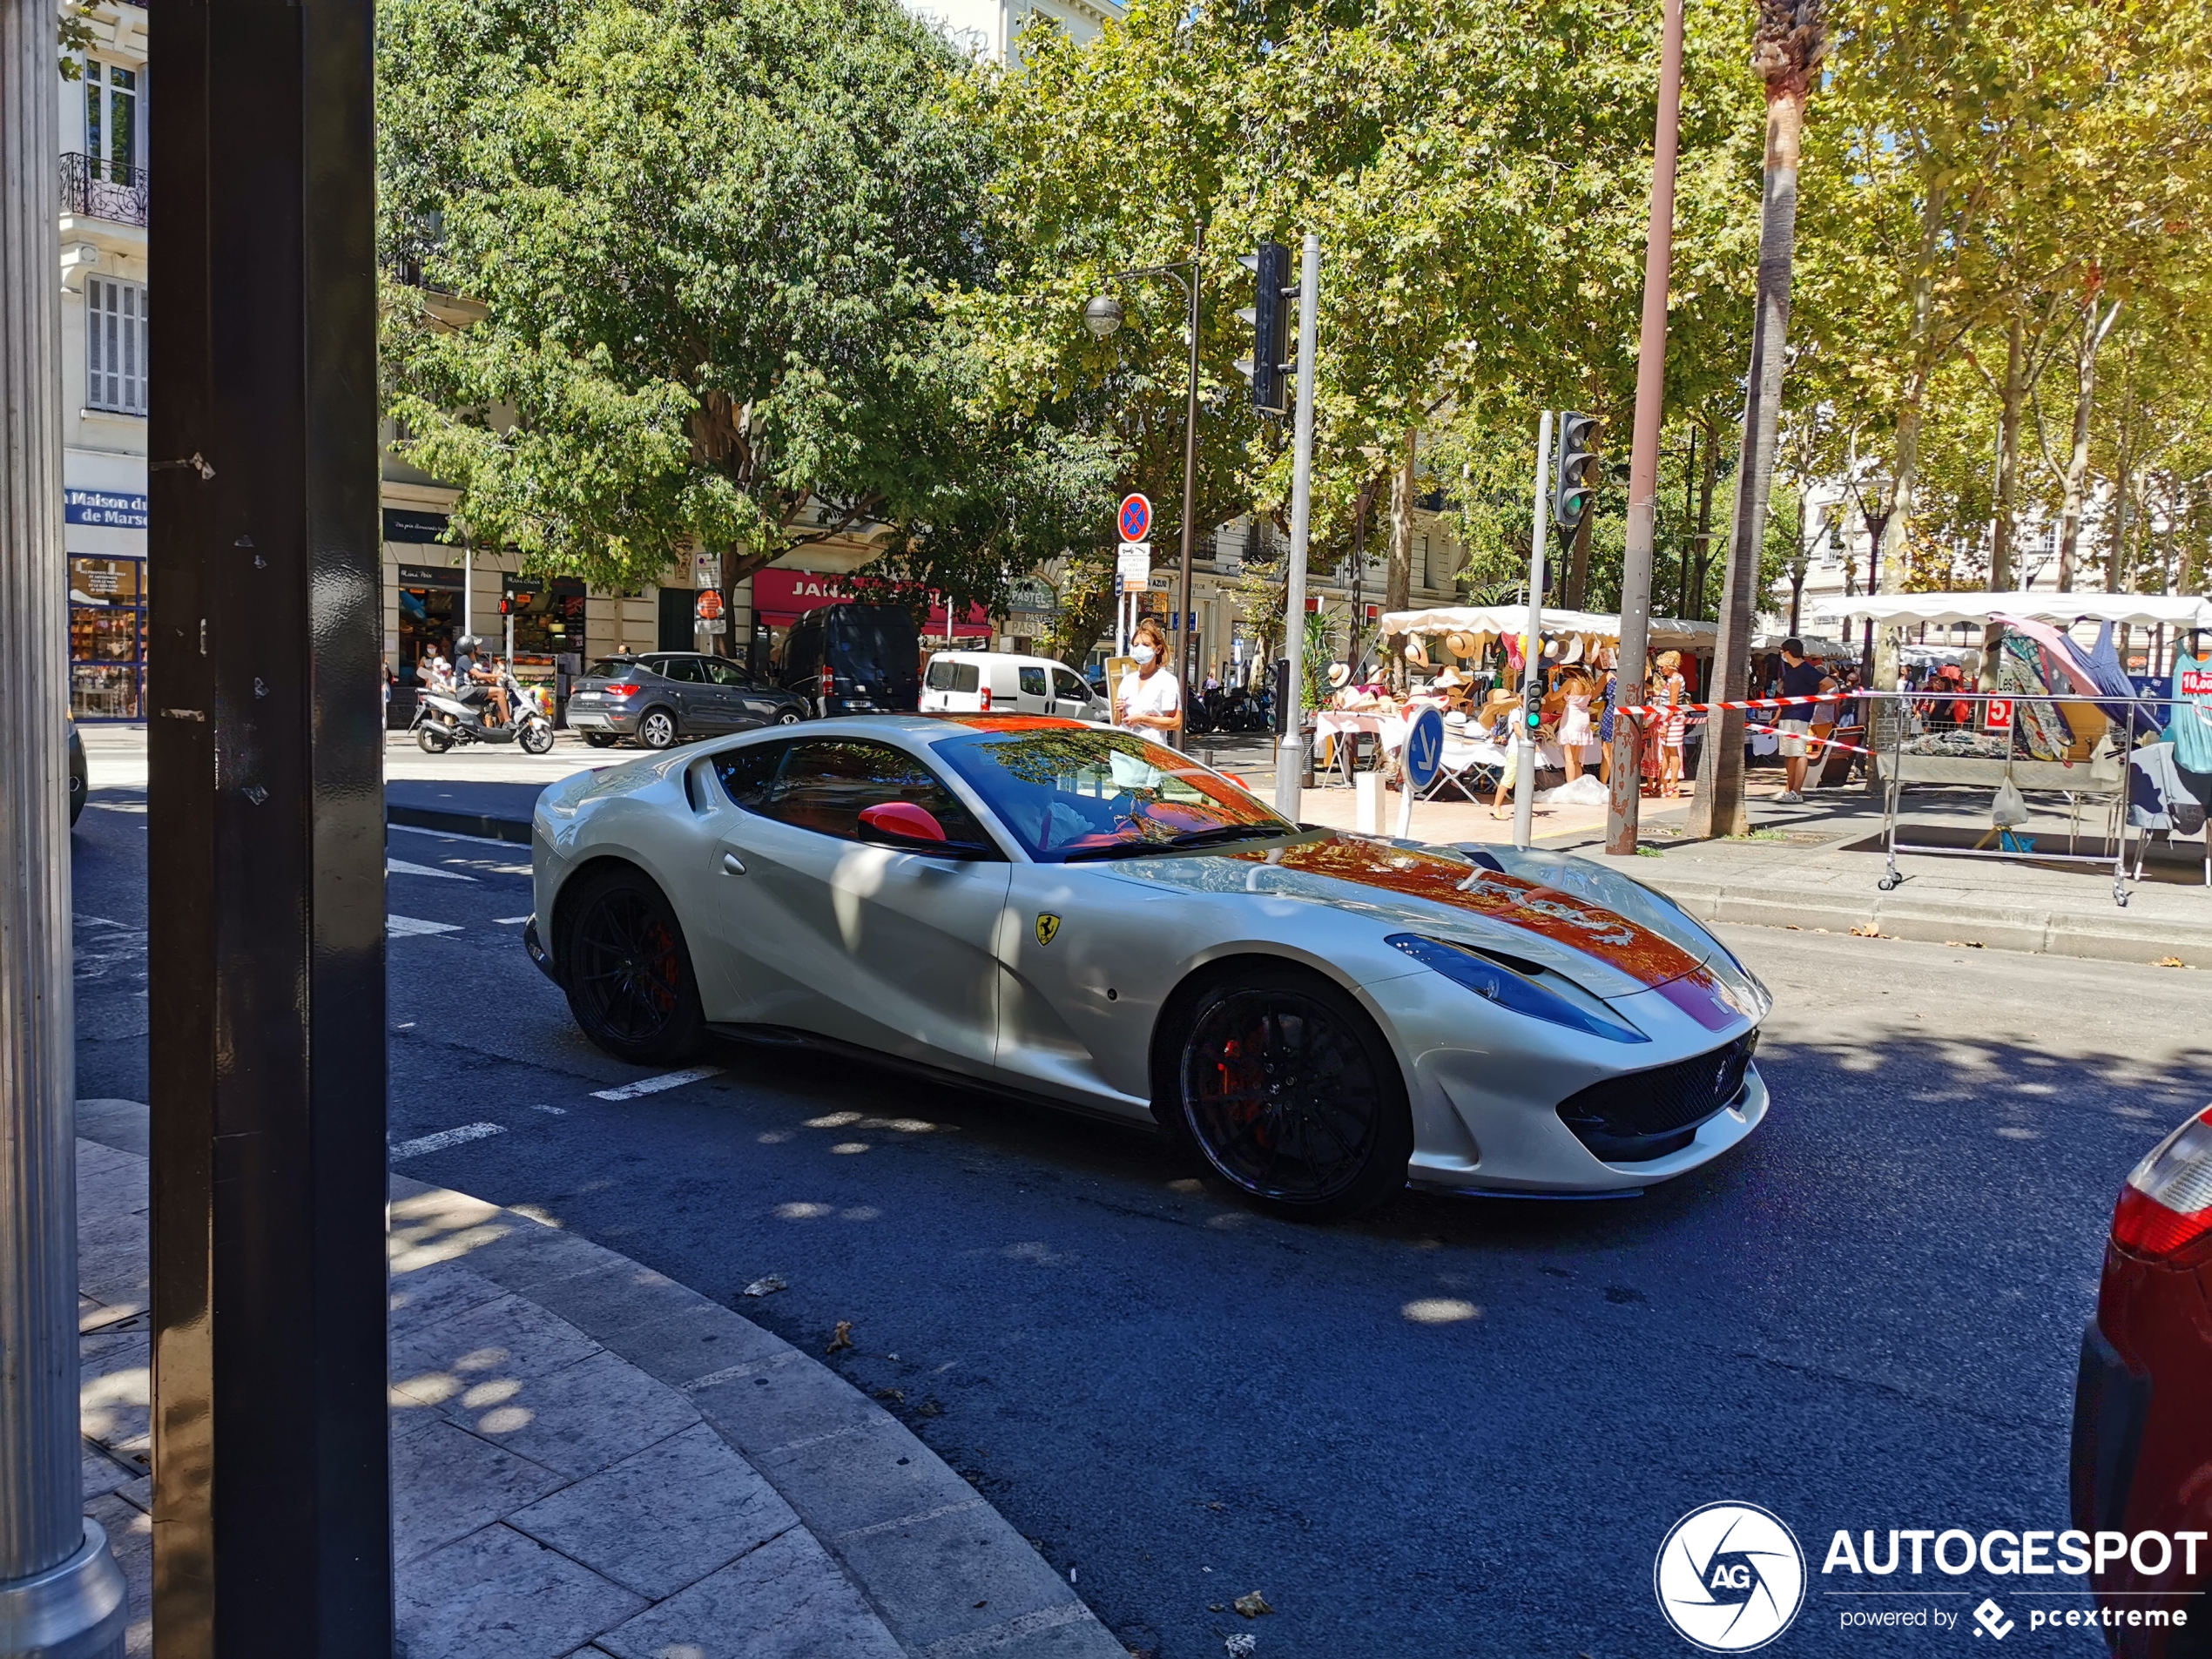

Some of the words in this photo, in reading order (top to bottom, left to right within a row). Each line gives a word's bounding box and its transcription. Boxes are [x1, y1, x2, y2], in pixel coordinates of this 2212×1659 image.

[71, 491, 128, 509] Maison
[82, 509, 102, 523] de
[1152, 579, 1167, 588] AZUR
[1011, 590, 1046, 604] PASTEL
[1998, 673, 2013, 691] Les
